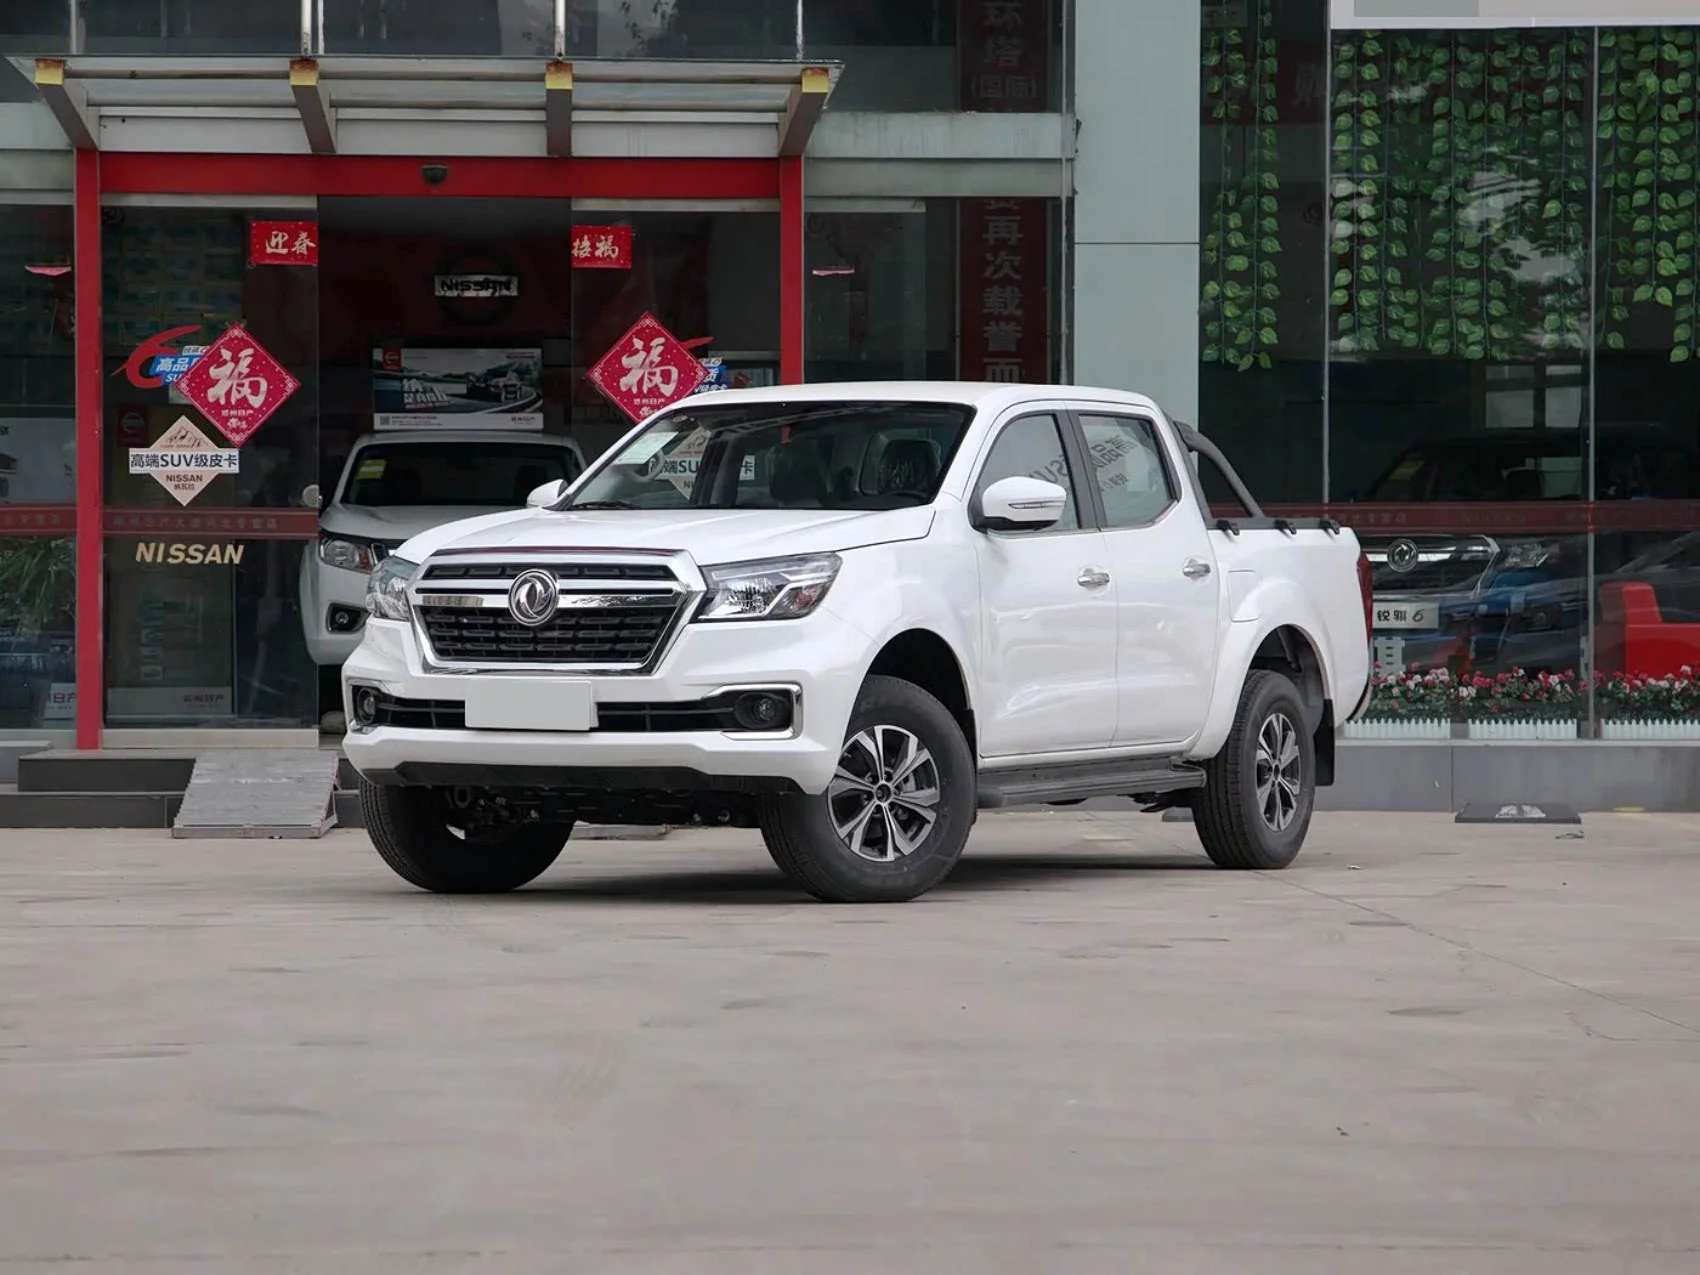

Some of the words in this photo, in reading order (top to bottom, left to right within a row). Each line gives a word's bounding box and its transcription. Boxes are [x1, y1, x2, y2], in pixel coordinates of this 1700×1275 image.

[264, 230, 317, 256] 迎春
[571, 235, 619, 259] 接福
[440, 277, 512, 293] NISSAN
[620, 335, 678, 397] 福
[206, 347, 268, 409] 福
[130, 453, 238, 468] 高端SUV级皮卡
[165, 474, 203, 483] NISSAN
[135, 542, 244, 565] NISSAN
[1411, 608, 1425, 623] 6
